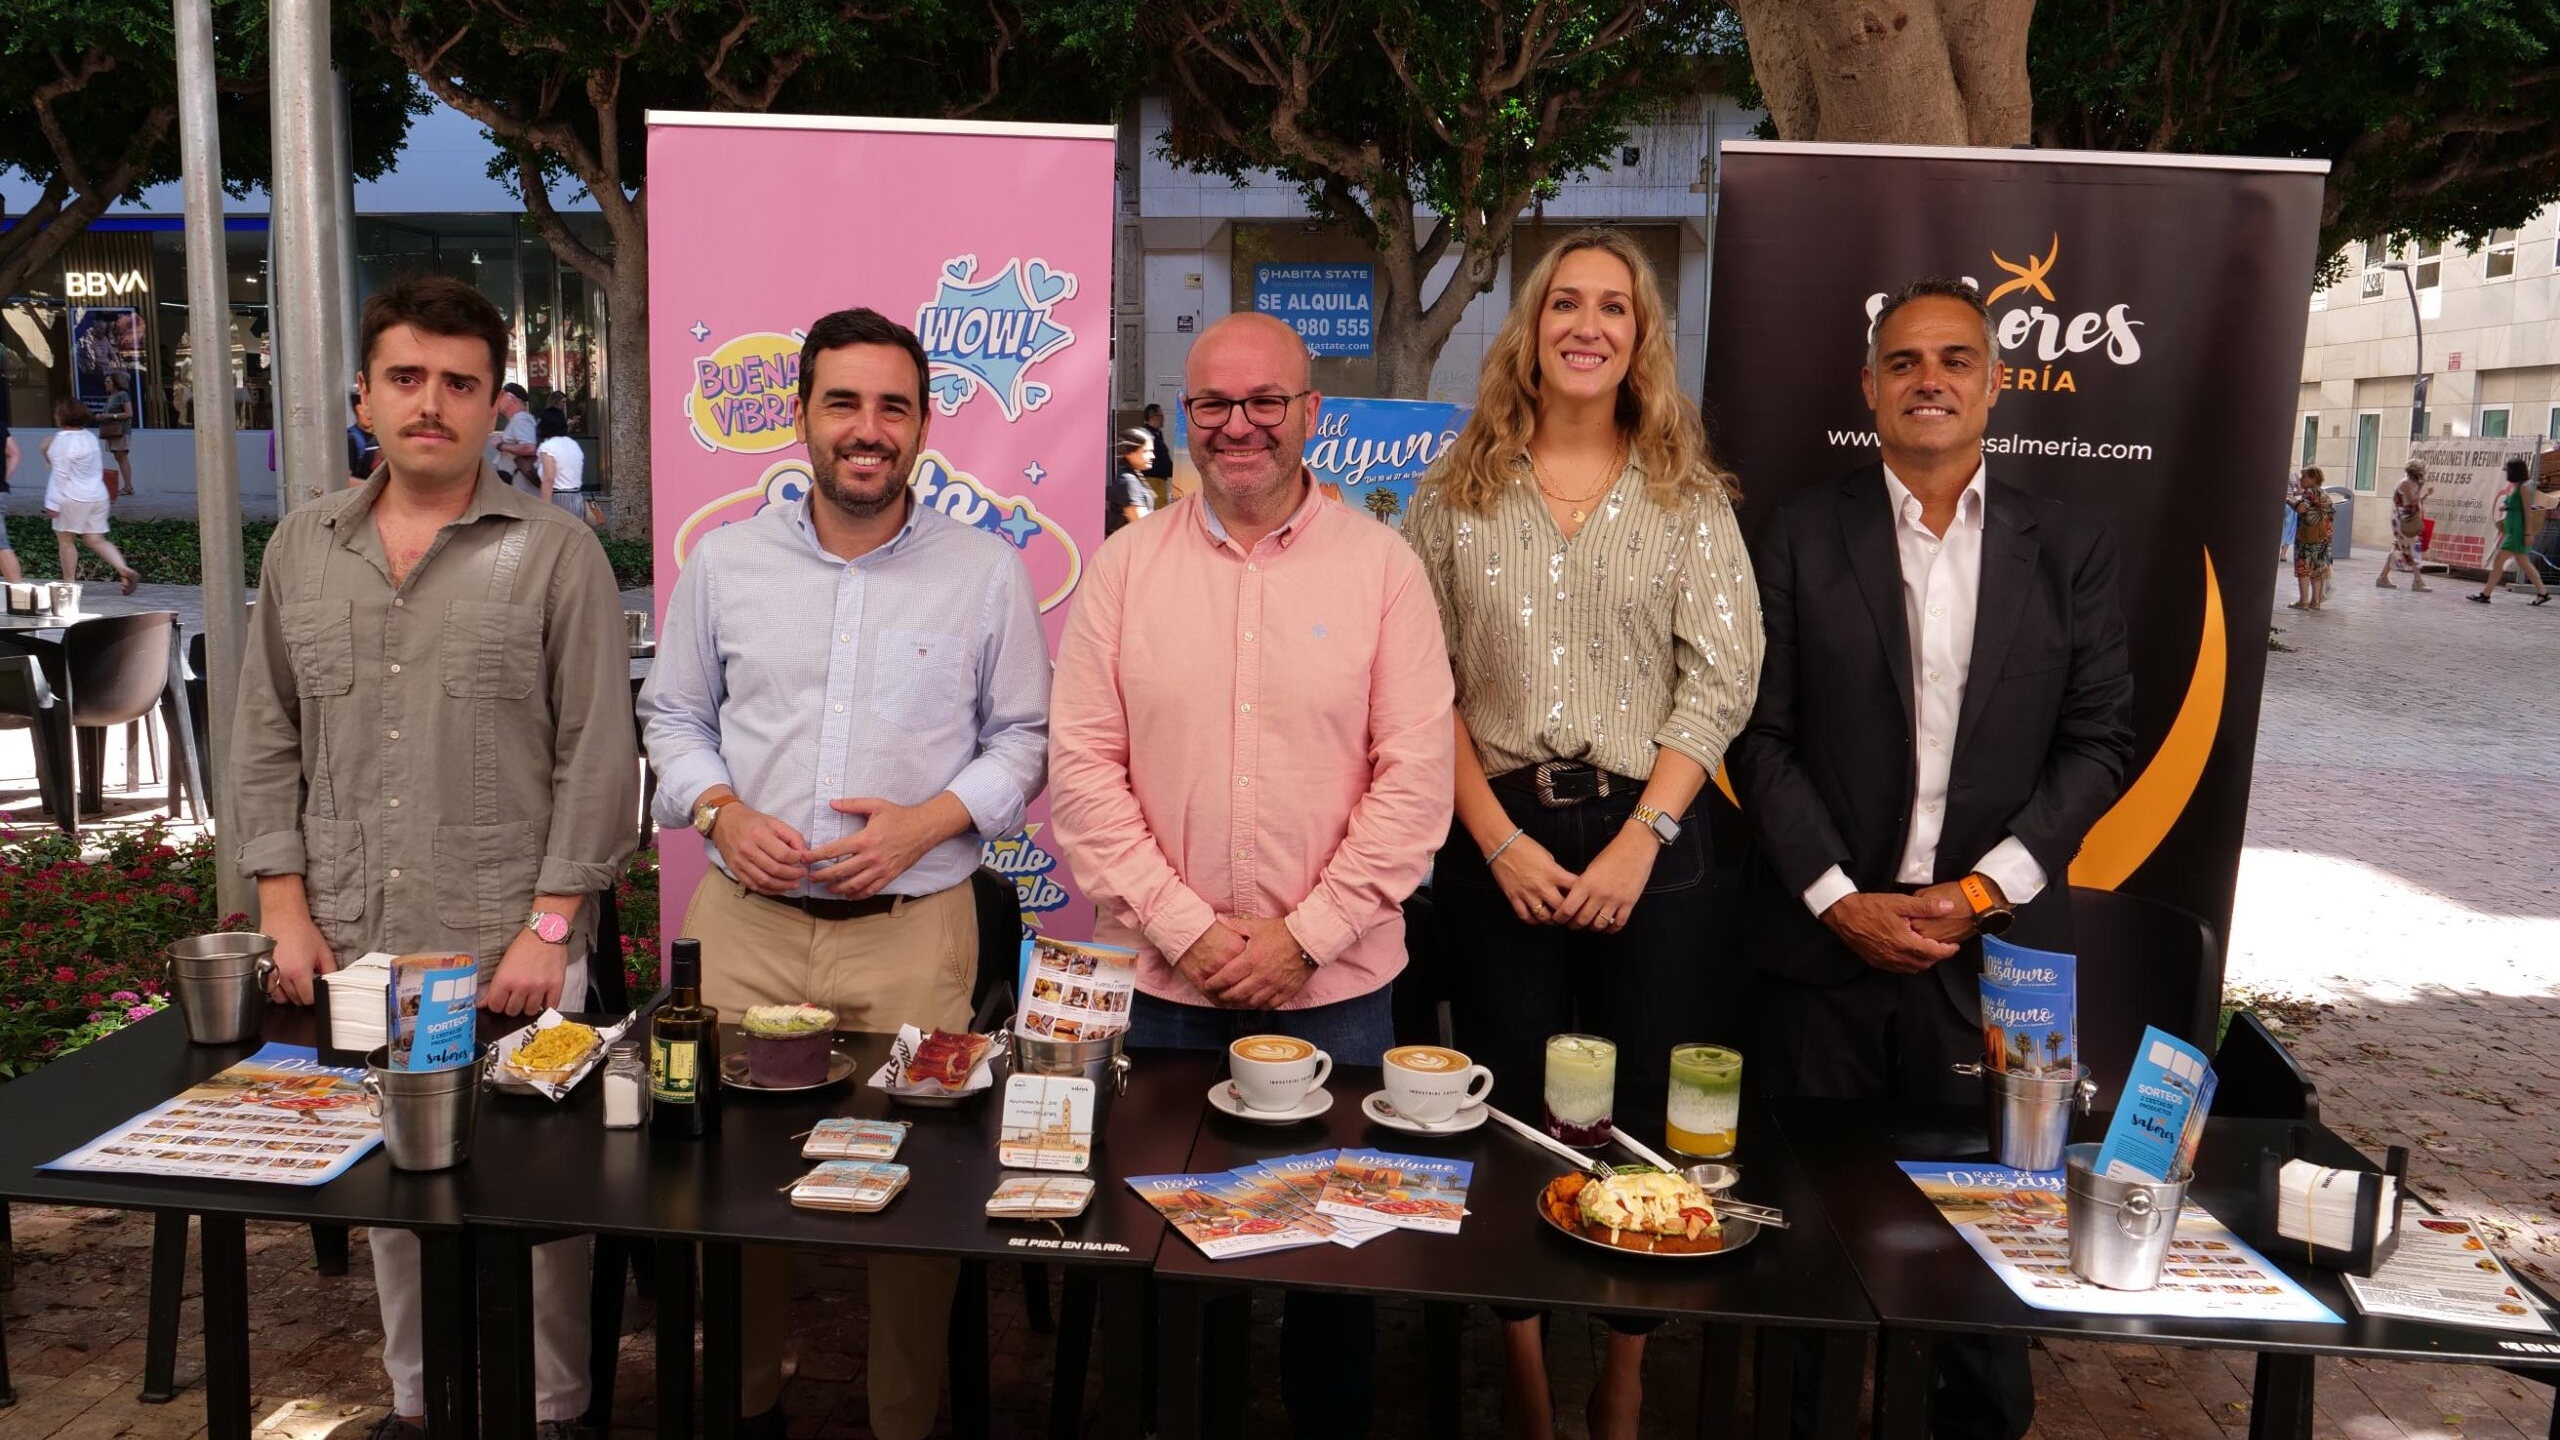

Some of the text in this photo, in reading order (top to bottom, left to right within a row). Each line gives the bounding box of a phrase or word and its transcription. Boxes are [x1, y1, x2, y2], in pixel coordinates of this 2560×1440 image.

[65, 270, 148, 297] BBVA
[1271, 270, 1368, 279] HABITA STATE
[1258, 293, 1369, 311] SE ALQUILA
[921, 306, 1046, 359] WOW!
[1296, 318, 1370, 336] 980 555
[1305, 341, 1369, 351] itastate.com
[2000, 364, 2077, 393] ERÍA
[1317, 413, 1350, 438] del
[426, 1014, 469, 1034] SORTEOS
[2137, 1083, 2183, 1105] SORTEOS
[1946, 1171, 2067, 1192] Desay
[1008, 1238, 1130, 1252] SE PIDE EN BARRA
